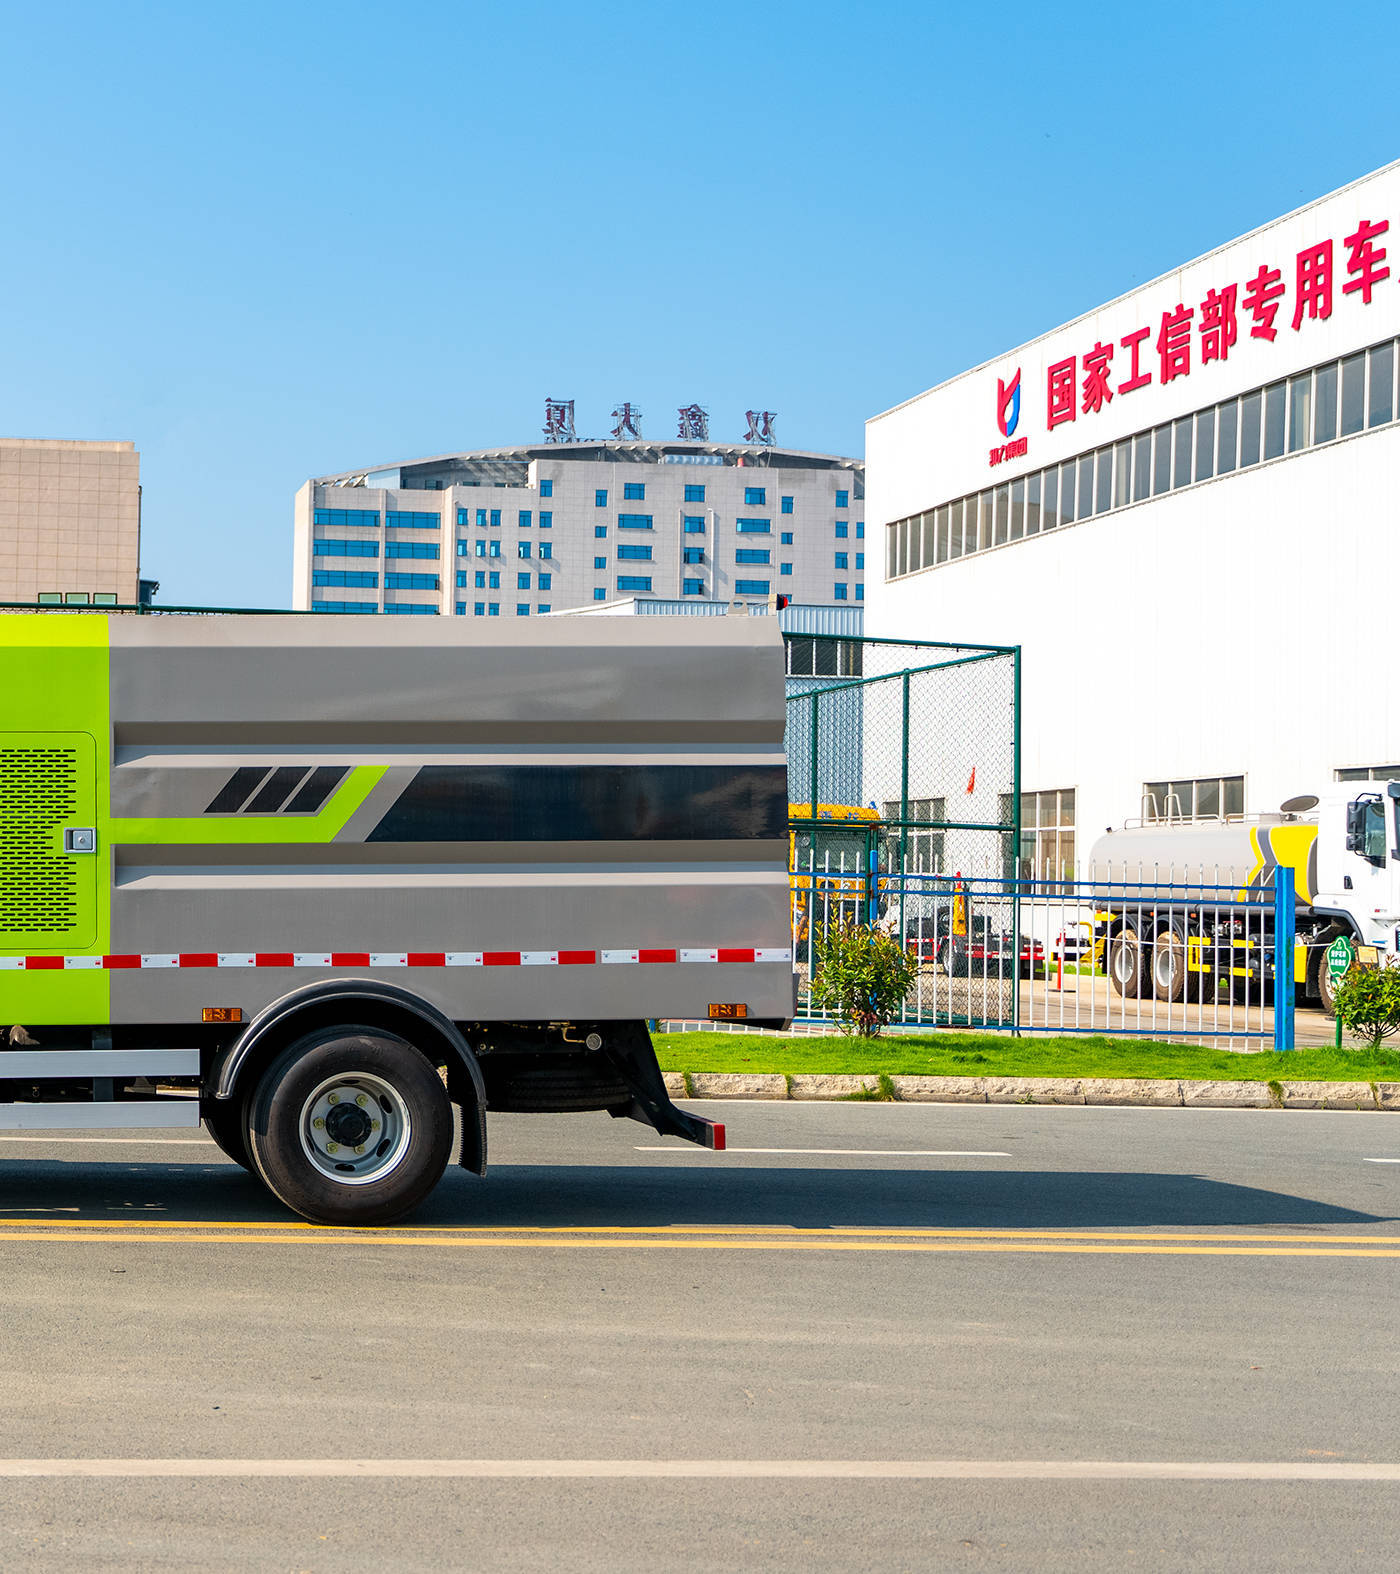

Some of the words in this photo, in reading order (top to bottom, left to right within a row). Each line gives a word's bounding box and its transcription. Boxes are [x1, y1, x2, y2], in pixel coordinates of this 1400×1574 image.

[1046, 219, 1400, 431] 国家工信部专用车
